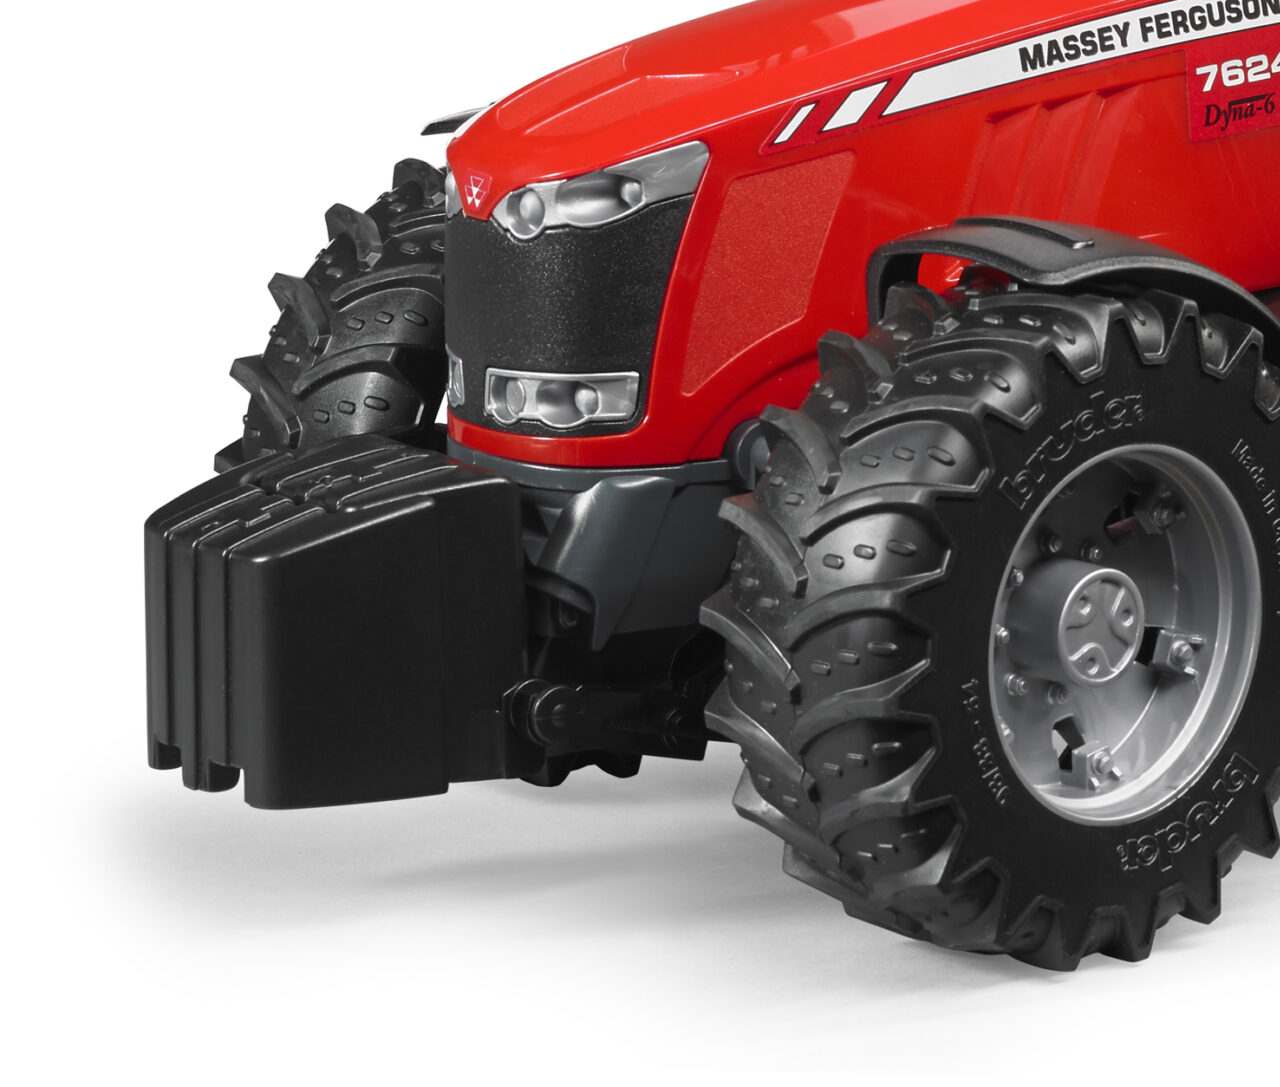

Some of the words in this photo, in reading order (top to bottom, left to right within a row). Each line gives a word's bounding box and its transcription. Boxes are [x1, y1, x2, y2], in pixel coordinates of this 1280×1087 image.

[1018, 21, 1131, 73] MASSEY
[1203, 92, 1277, 131] Dyna-6
[1231, 437, 1265, 490] Made
[1261, 489, 1277, 515] in
